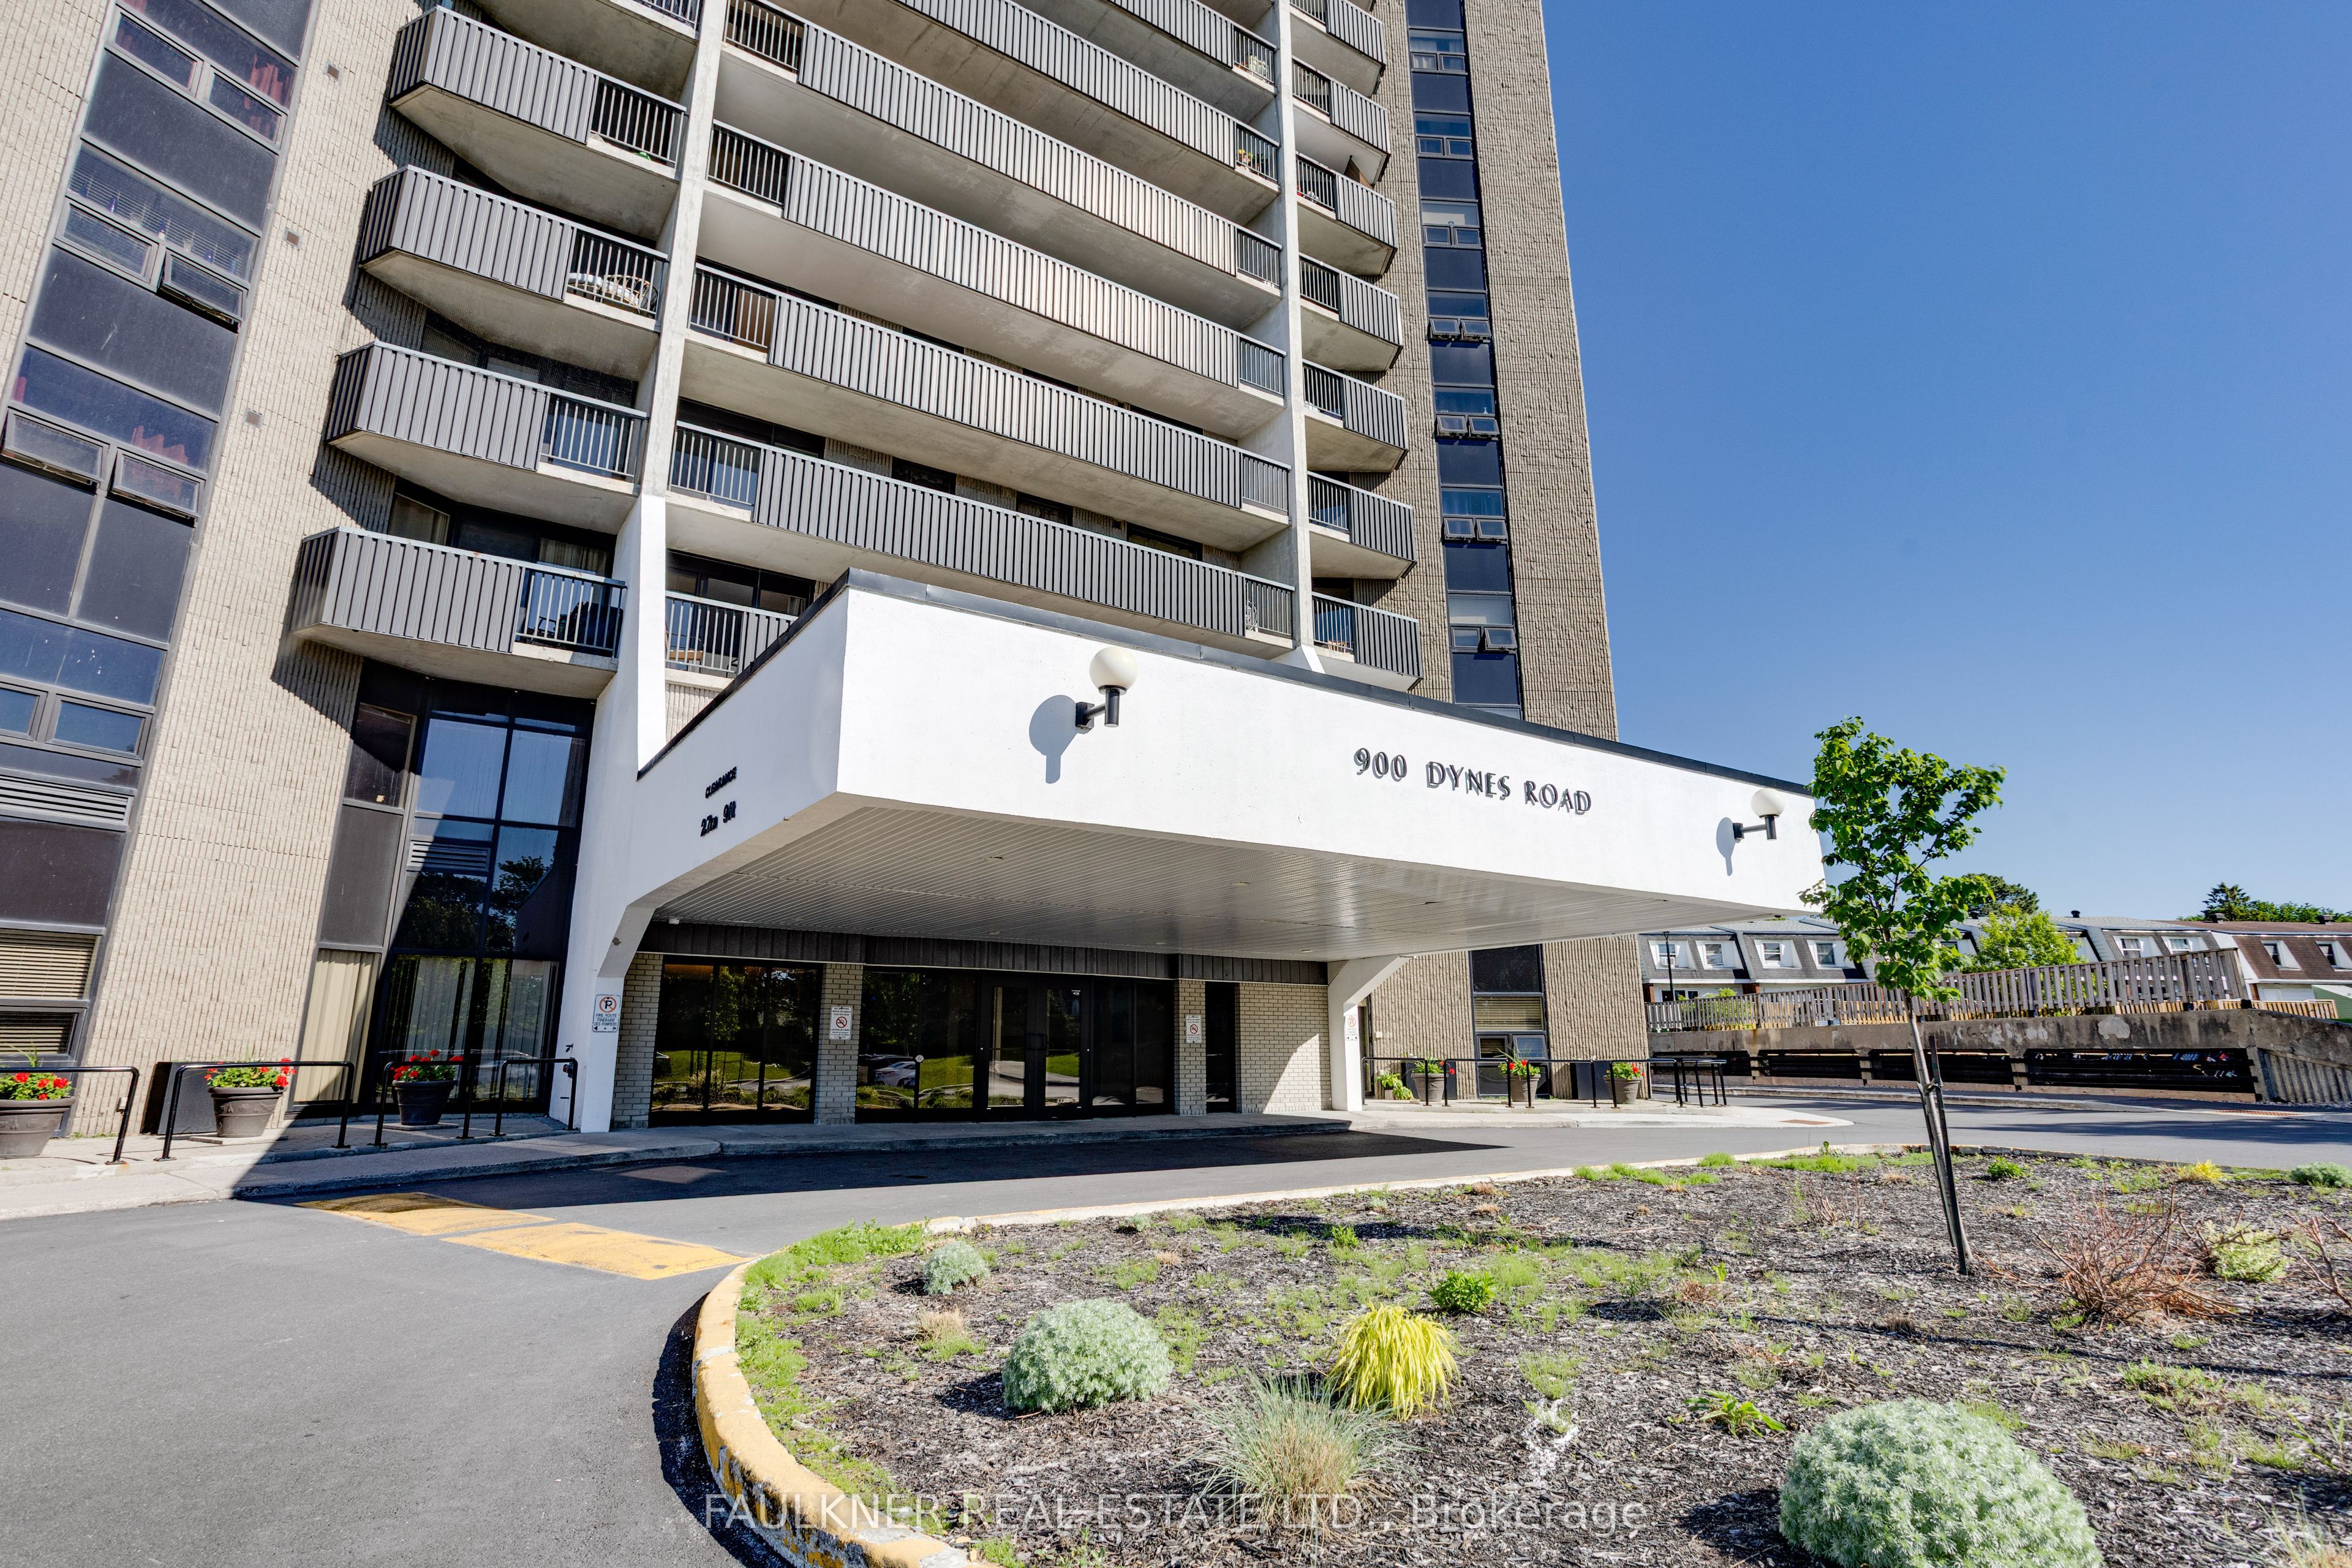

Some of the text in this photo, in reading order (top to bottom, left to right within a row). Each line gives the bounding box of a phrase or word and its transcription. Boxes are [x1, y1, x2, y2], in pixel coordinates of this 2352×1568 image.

[705, 766, 737, 799] CLEARANCE
[1355, 747, 1592, 813] 900 DYNES ROAD
